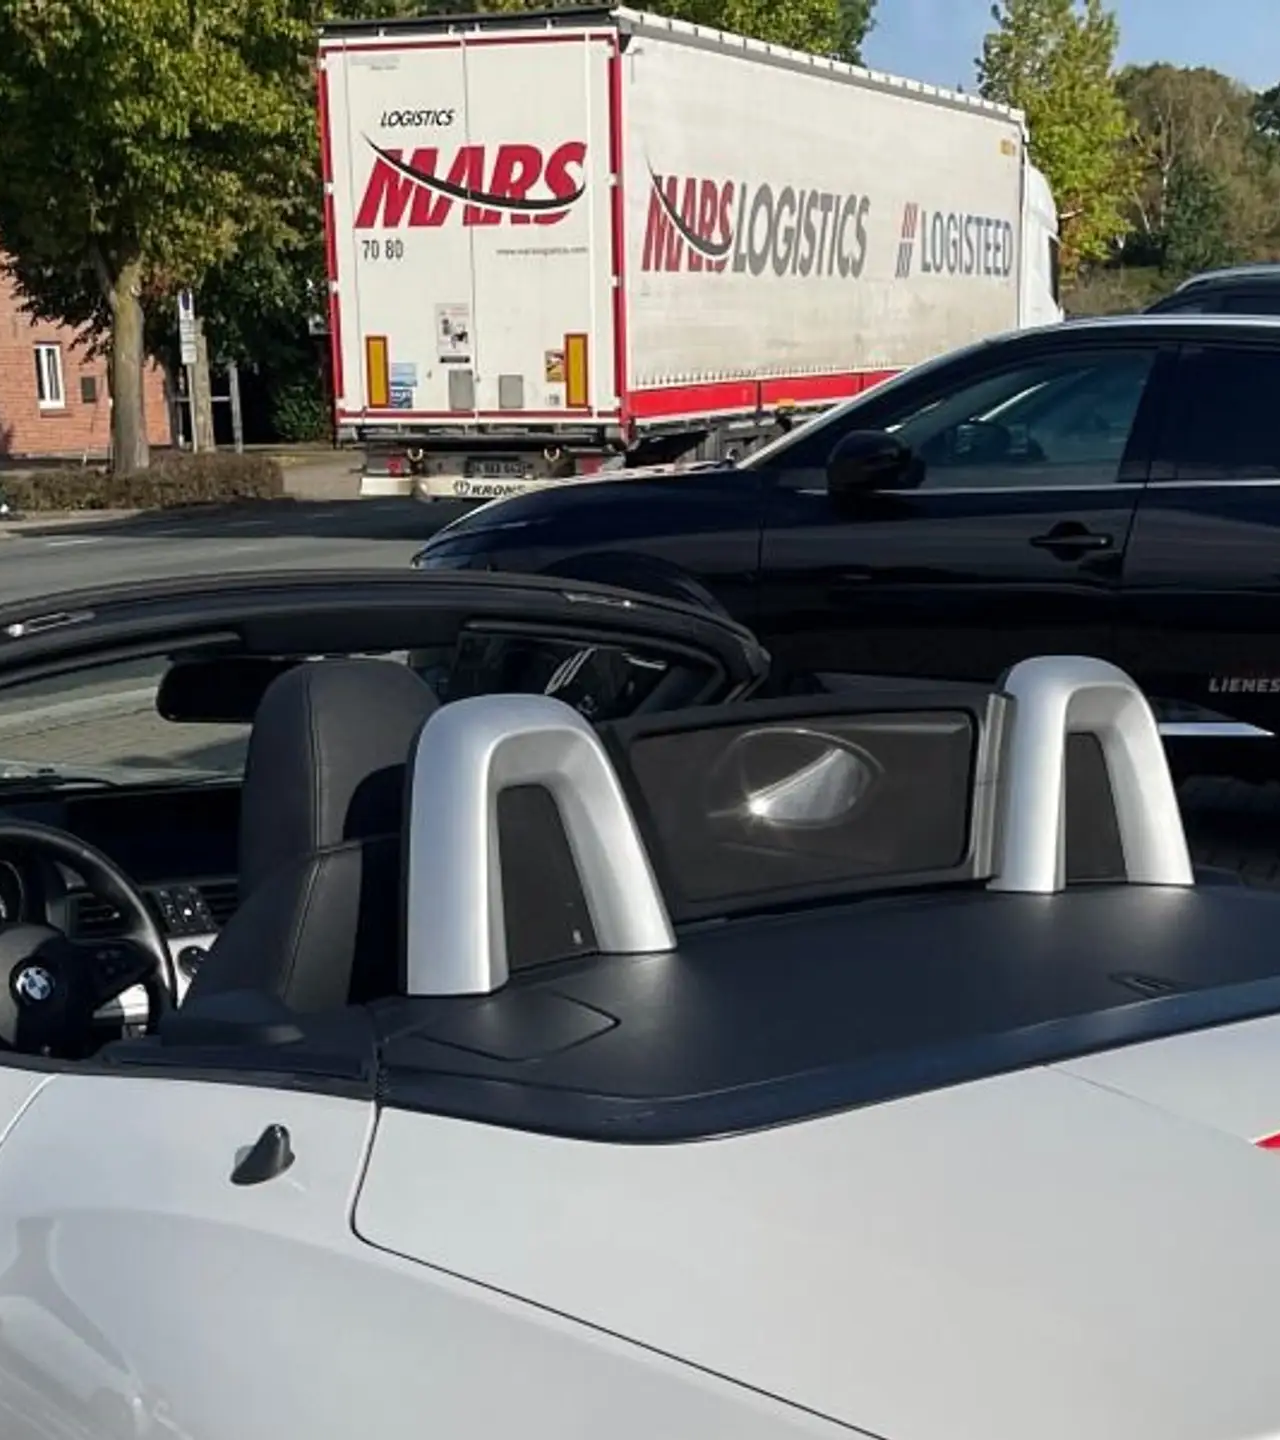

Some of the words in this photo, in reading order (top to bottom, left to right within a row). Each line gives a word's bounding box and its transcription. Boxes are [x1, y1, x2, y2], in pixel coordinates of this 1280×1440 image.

[380, 109, 455, 127] LOGISTICS
[353, 141, 588, 229] MARS
[362, 241, 379, 260] 70
[385, 240, 404, 259] 80
[641, 174, 734, 274] MARS
[732, 182, 871, 278] LOGISTICS
[921, 210, 1013, 277] LOGISTEED
